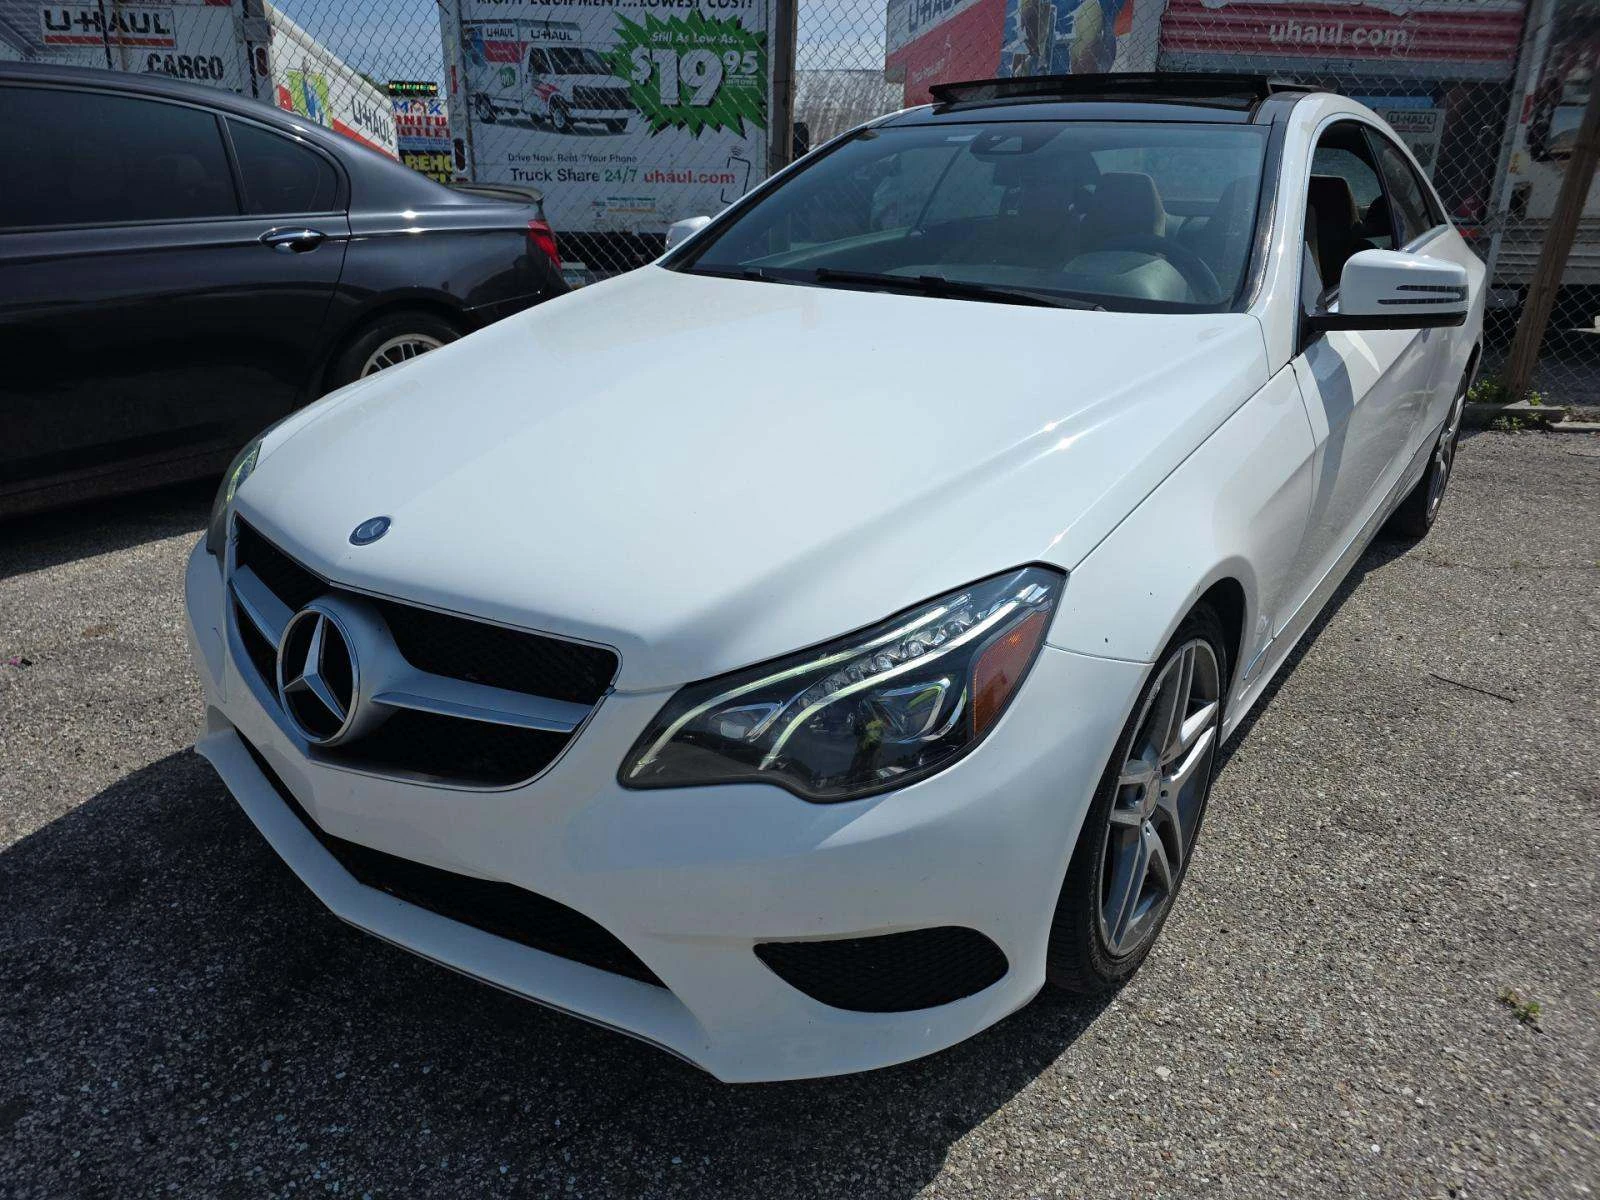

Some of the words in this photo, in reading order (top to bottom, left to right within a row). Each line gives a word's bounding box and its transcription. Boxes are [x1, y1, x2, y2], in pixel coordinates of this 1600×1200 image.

[651, 31, 673, 42] Still
[694, 32, 718, 43] Low
[1269, 20, 1409, 47] uhaul.com
[147, 53, 224, 80] CARGO
[508, 153, 530, 162] Drive
[609, 154, 638, 164] Phone
[510, 167, 553, 182] Truck
[557, 167, 600, 183] Share
[604, 166, 638, 184] 24/7
[644, 170, 736, 184] uhaul.com
